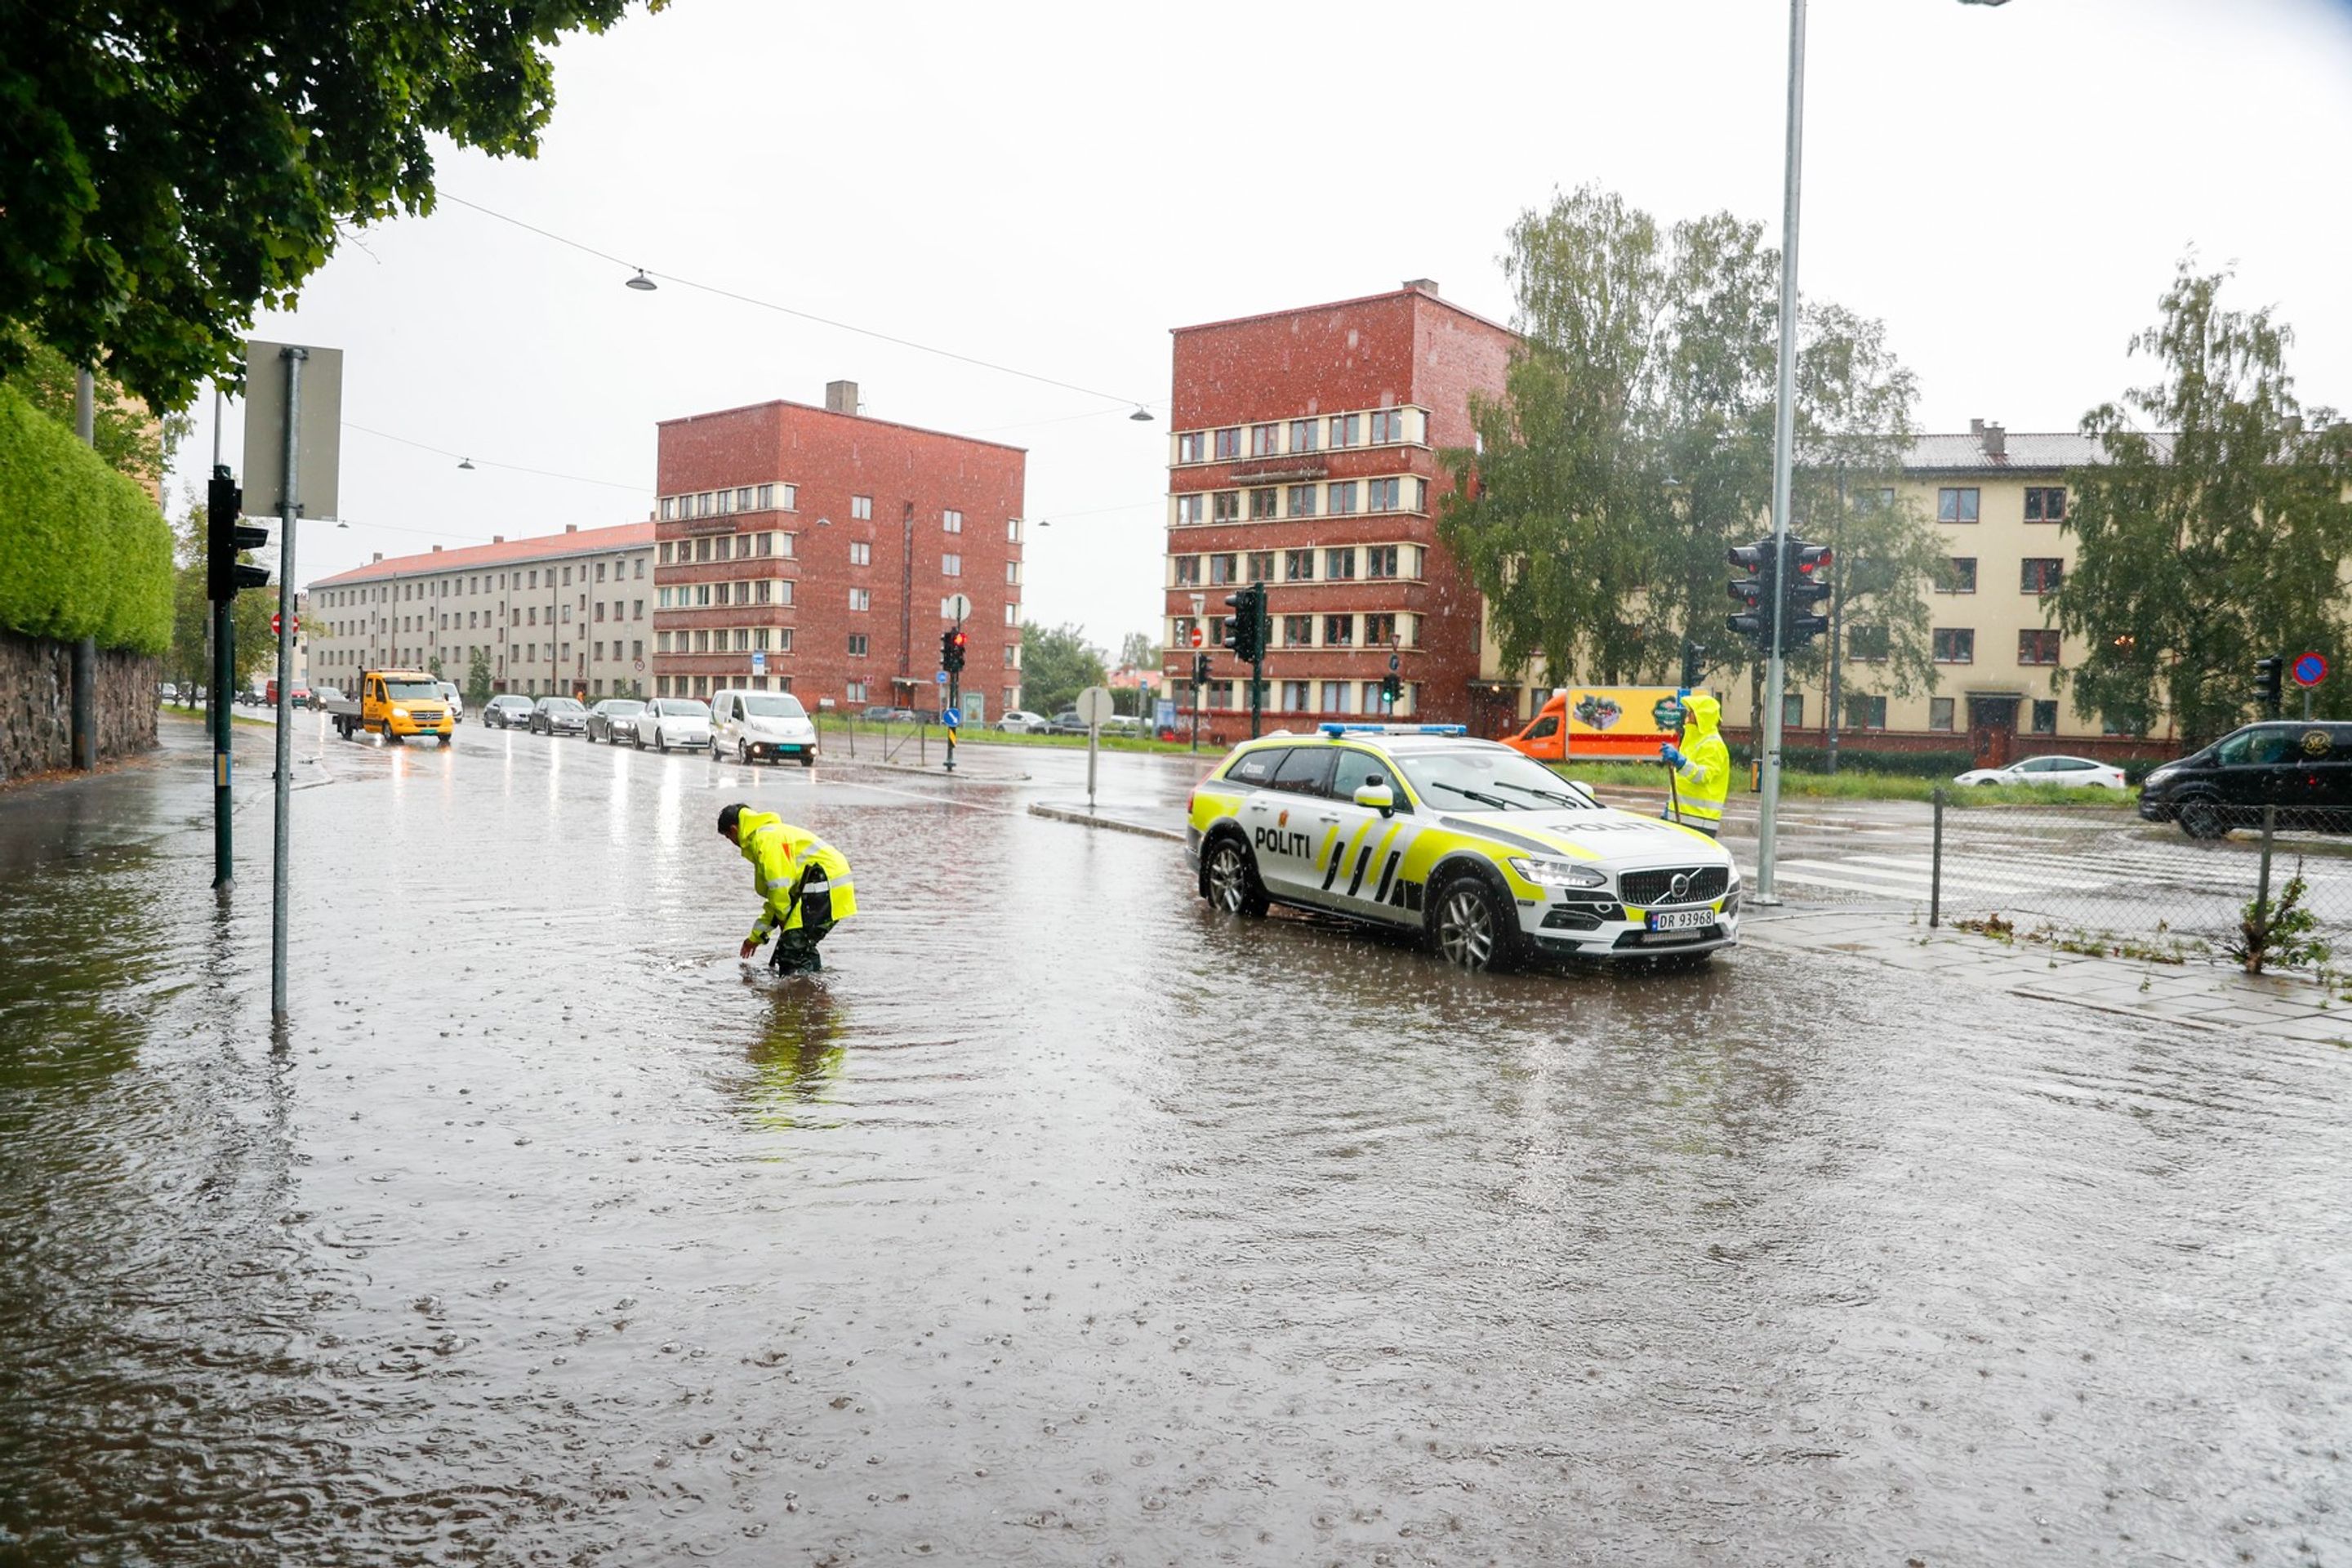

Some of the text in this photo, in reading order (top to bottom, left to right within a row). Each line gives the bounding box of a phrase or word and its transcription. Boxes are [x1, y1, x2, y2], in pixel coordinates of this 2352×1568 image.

[1548, 822, 1671, 834] POLITI
[1255, 826, 1311, 860] POLITI
[1659, 911, 1712, 929] DR 93968
